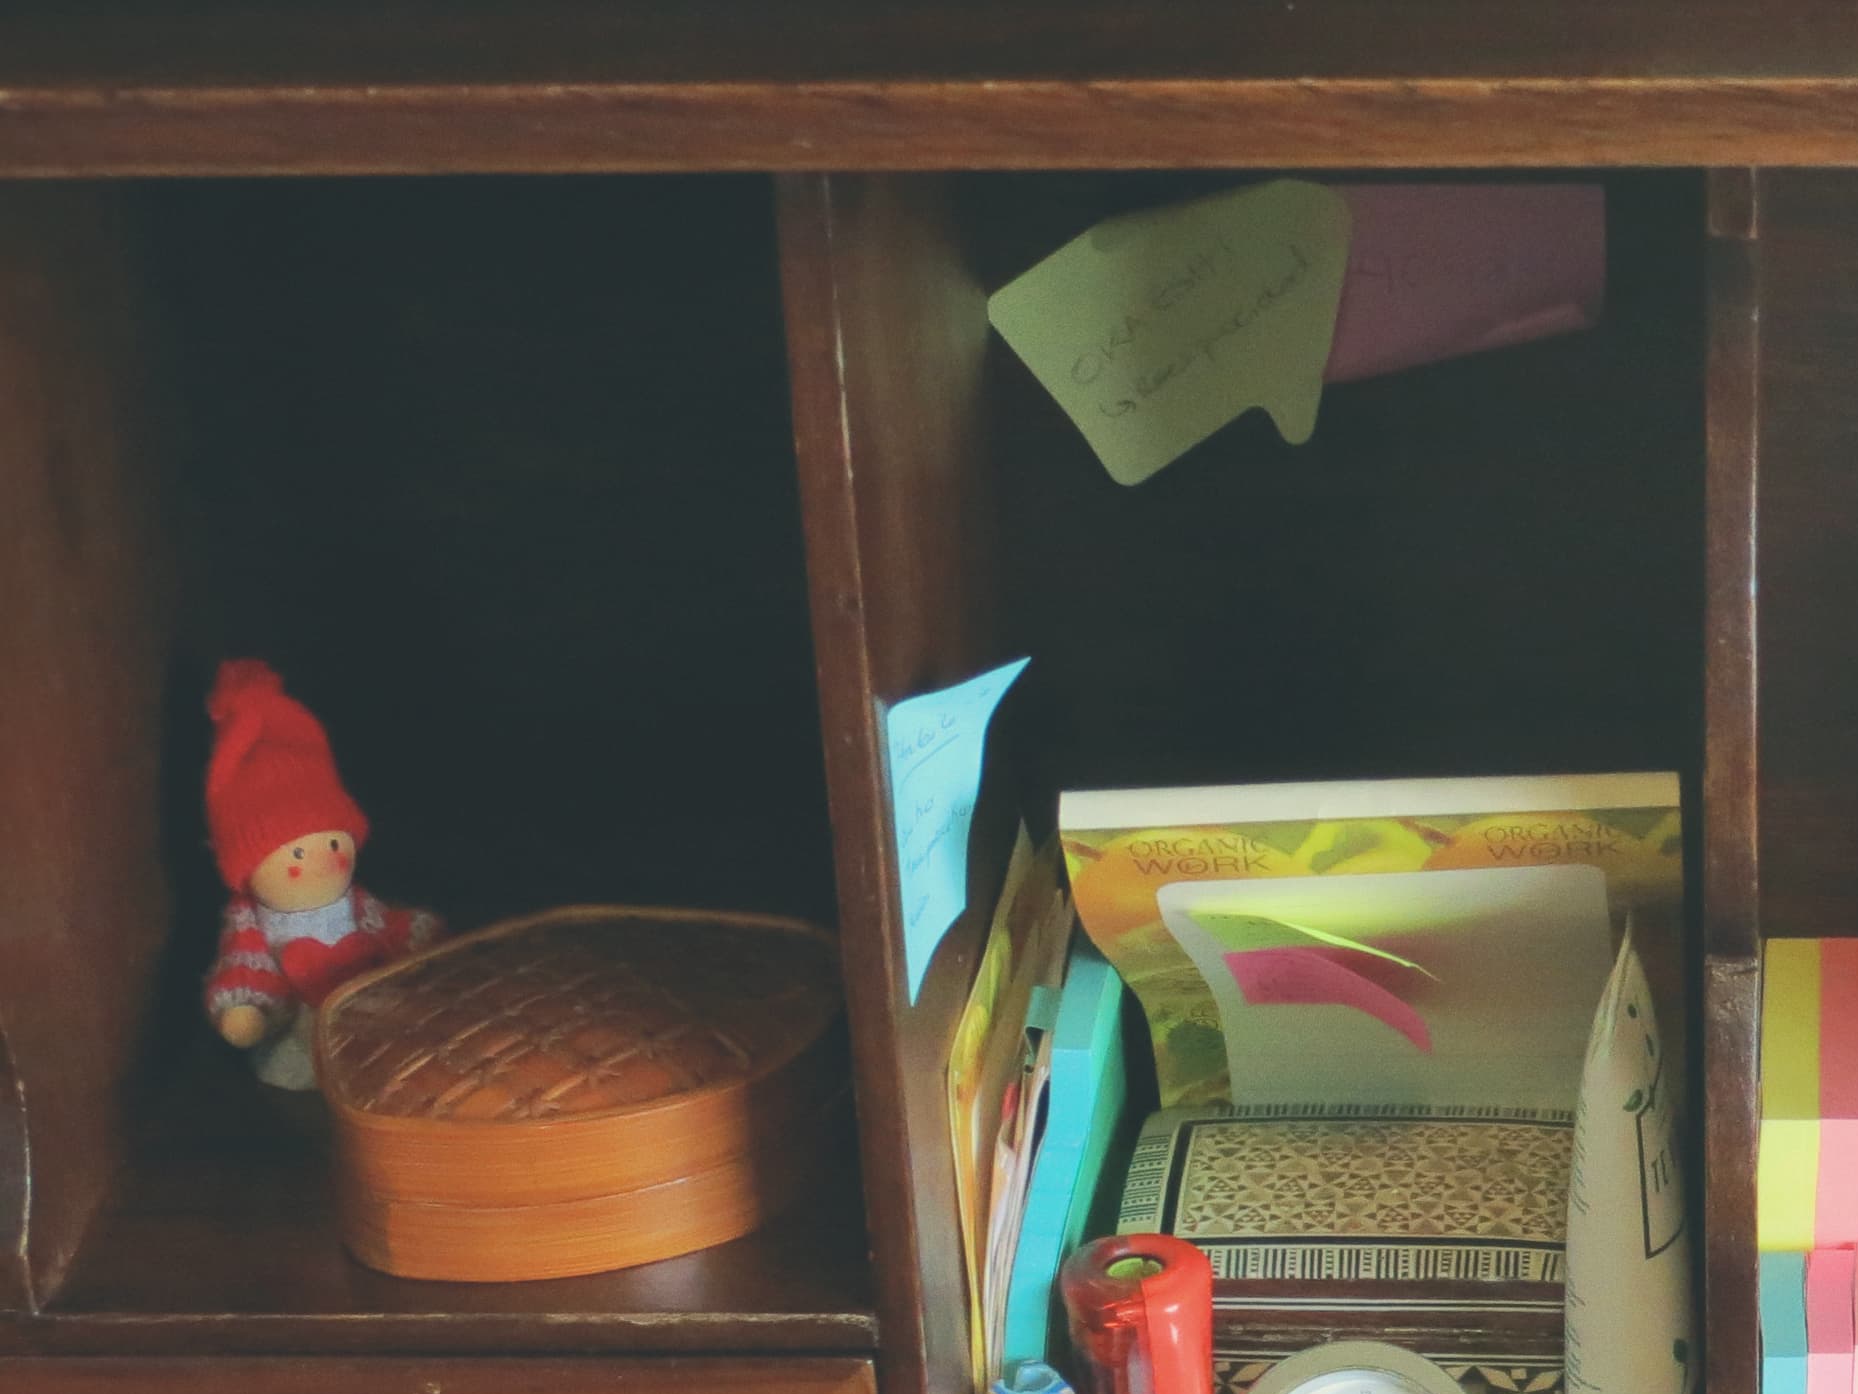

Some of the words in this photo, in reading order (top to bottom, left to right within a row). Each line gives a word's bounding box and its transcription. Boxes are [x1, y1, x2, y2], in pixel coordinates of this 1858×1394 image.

[1127, 836, 1269, 859] ORGANIC
[1487, 841, 1622, 863] WORK
[1132, 856, 1270, 877] WORK
